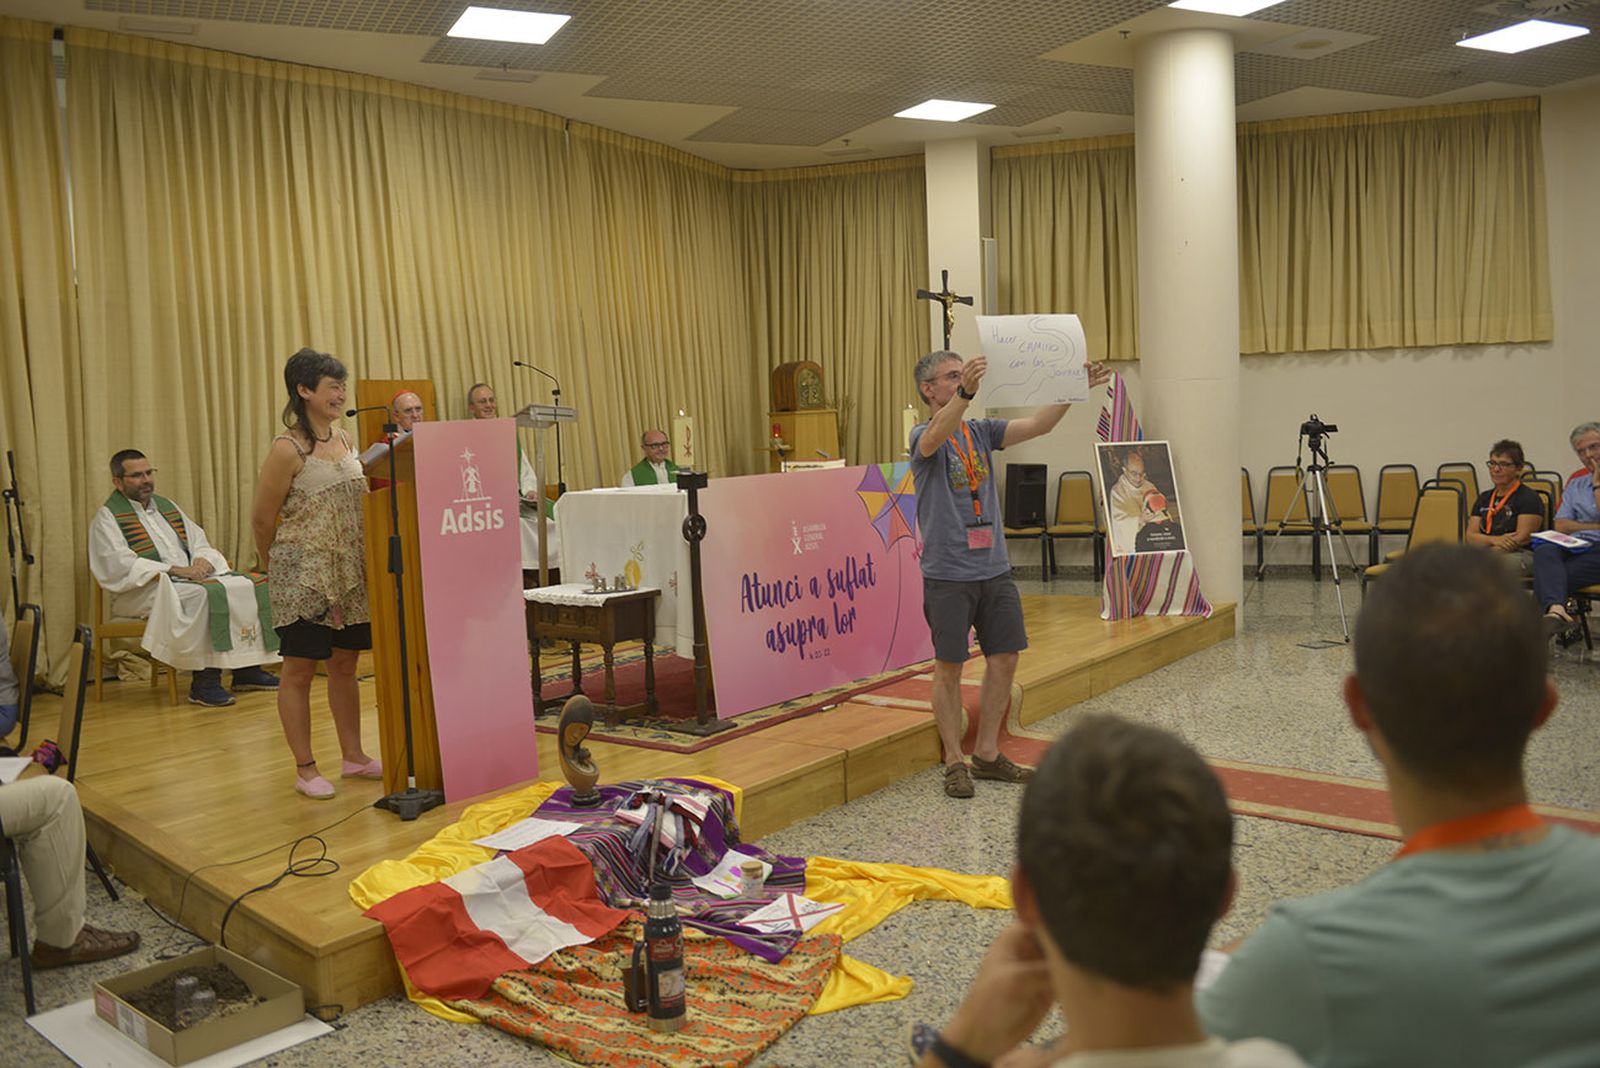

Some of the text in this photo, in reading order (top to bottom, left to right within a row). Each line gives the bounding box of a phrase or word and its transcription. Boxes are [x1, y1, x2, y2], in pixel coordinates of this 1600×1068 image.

[440, 502, 505, 535] Adsis
[741, 552, 877, 614] Atunci a suflat
[765, 601, 858, 661] asupra lor
